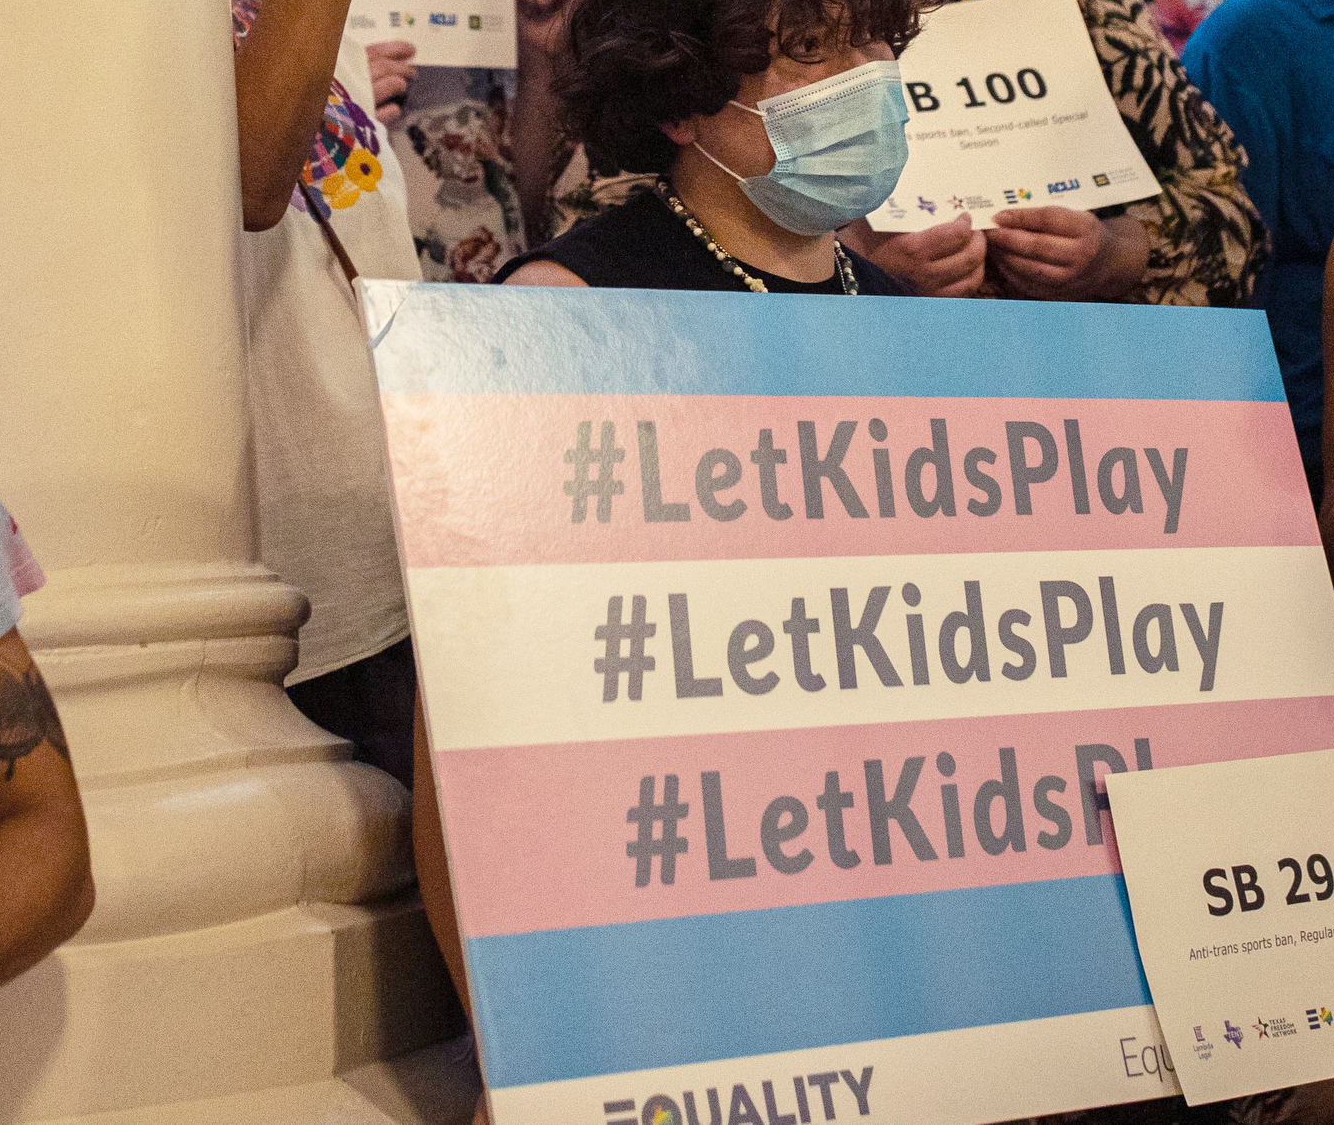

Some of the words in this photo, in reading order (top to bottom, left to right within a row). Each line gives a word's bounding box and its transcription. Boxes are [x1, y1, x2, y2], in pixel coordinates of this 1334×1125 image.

[906, 82, 940, 112] B
[956, 68, 1047, 108] 100
[563, 418, 1190, 535] #LetKidsPlay
[594, 575, 1225, 704] #LetKidsPlay
[1202, 864, 1266, 917] SB
[1189, 944, 1239, 961] Anti-trans
[1241, 937, 1273, 954] sports
[1275, 934, 1297, 947] ban,
[1269, 1017, 1286, 1025] TEXAS
[1271, 1023, 1295, 1032] FREEDOM
[1272, 1029, 1297, 1038] NETWORK
